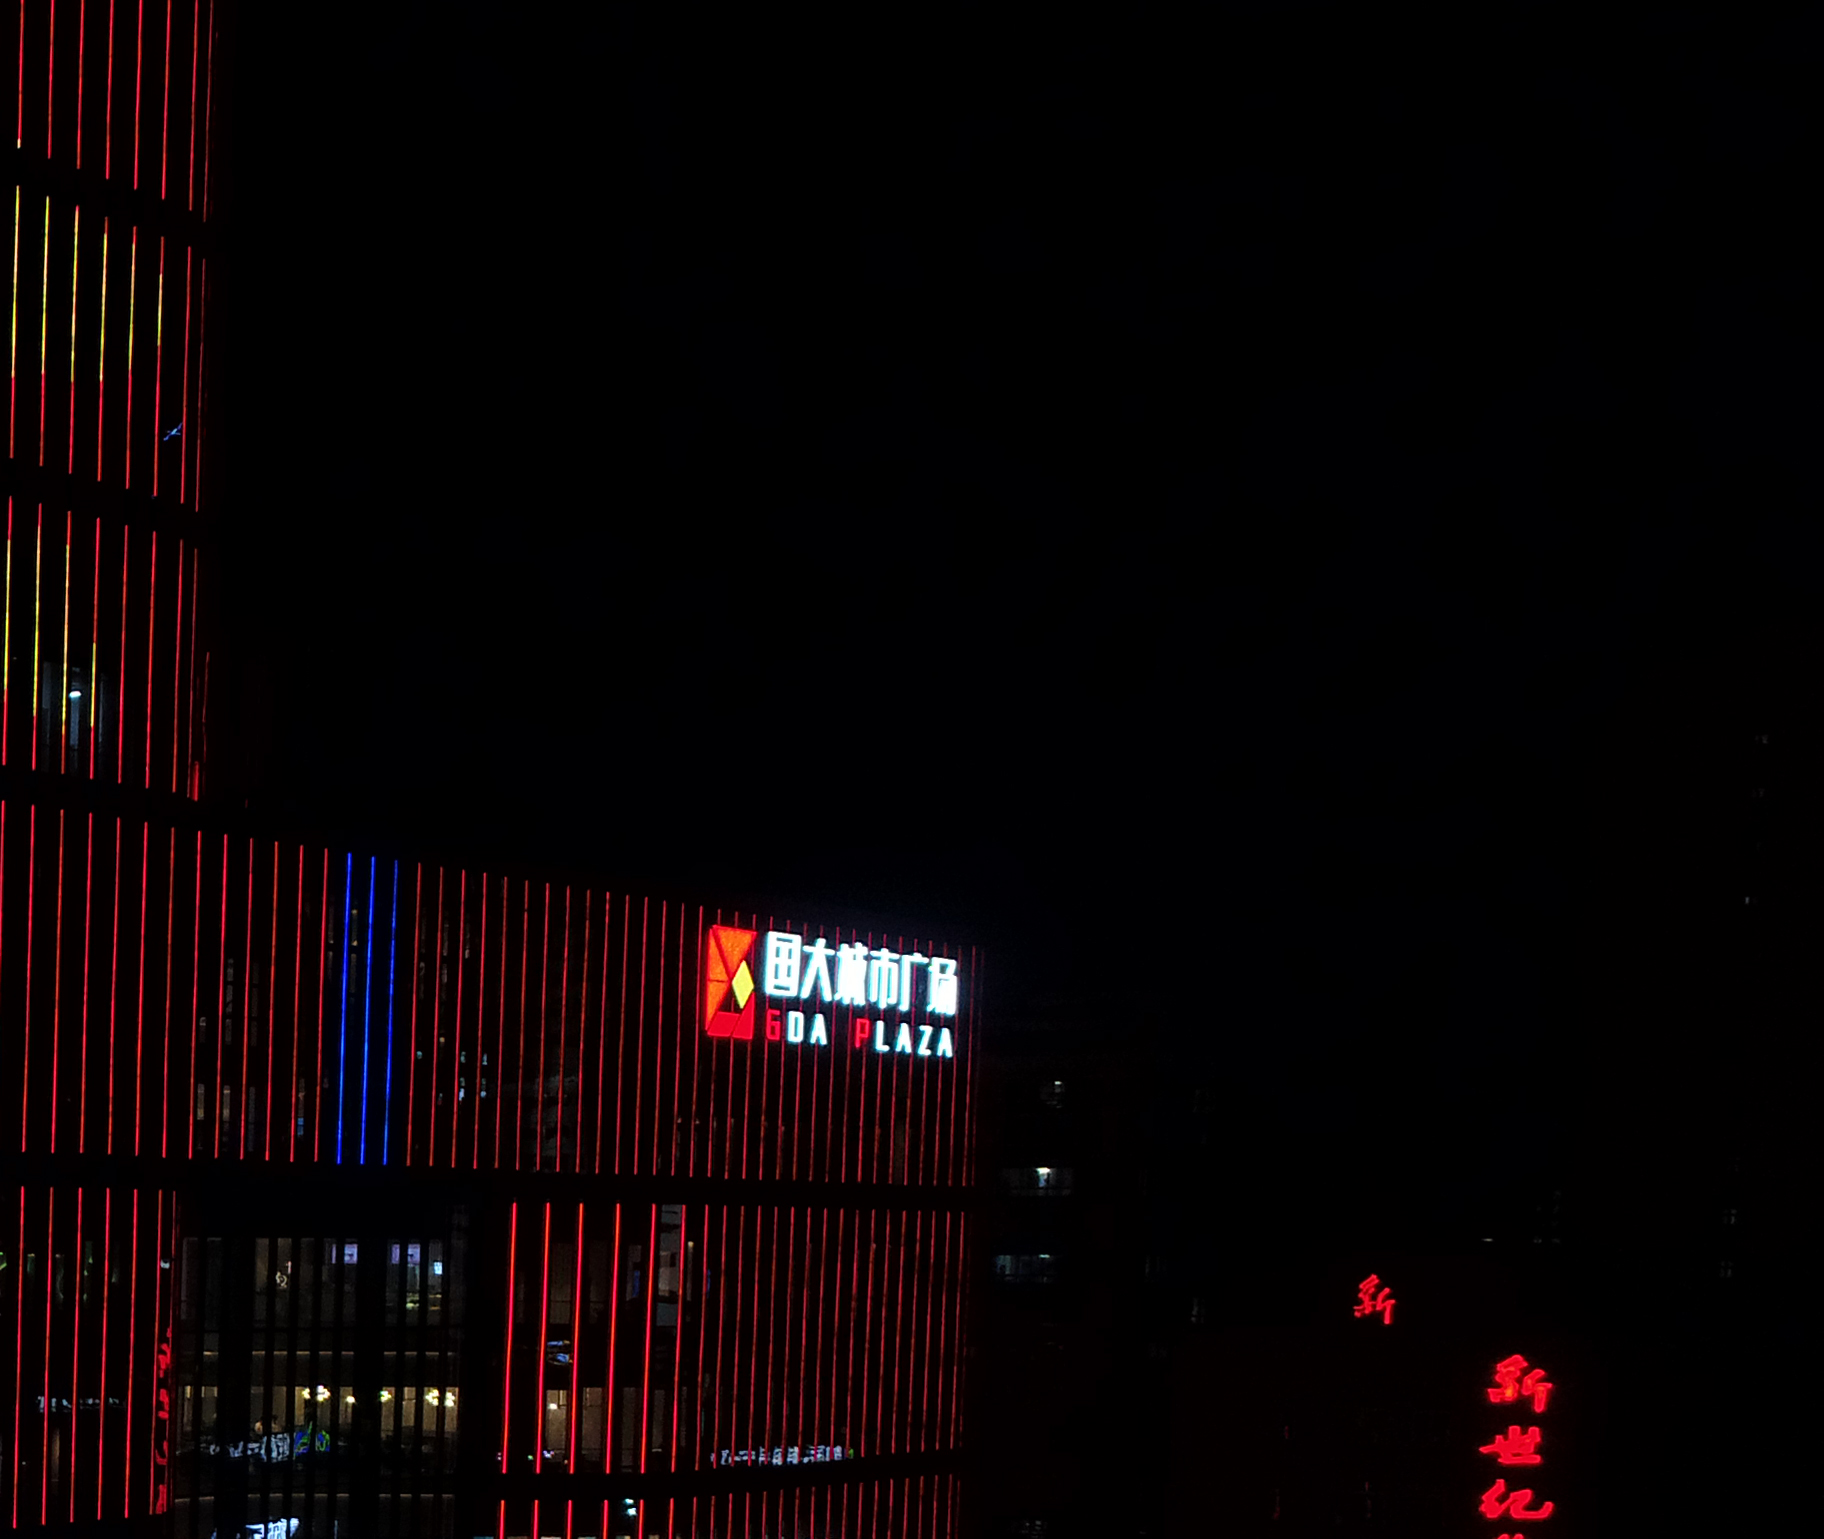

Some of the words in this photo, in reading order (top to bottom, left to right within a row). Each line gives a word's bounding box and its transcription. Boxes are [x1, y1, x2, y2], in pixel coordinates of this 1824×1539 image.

[763, 931, 958, 1015] 国大城市广场
[855, 1018, 954, 1058] PLAZA
